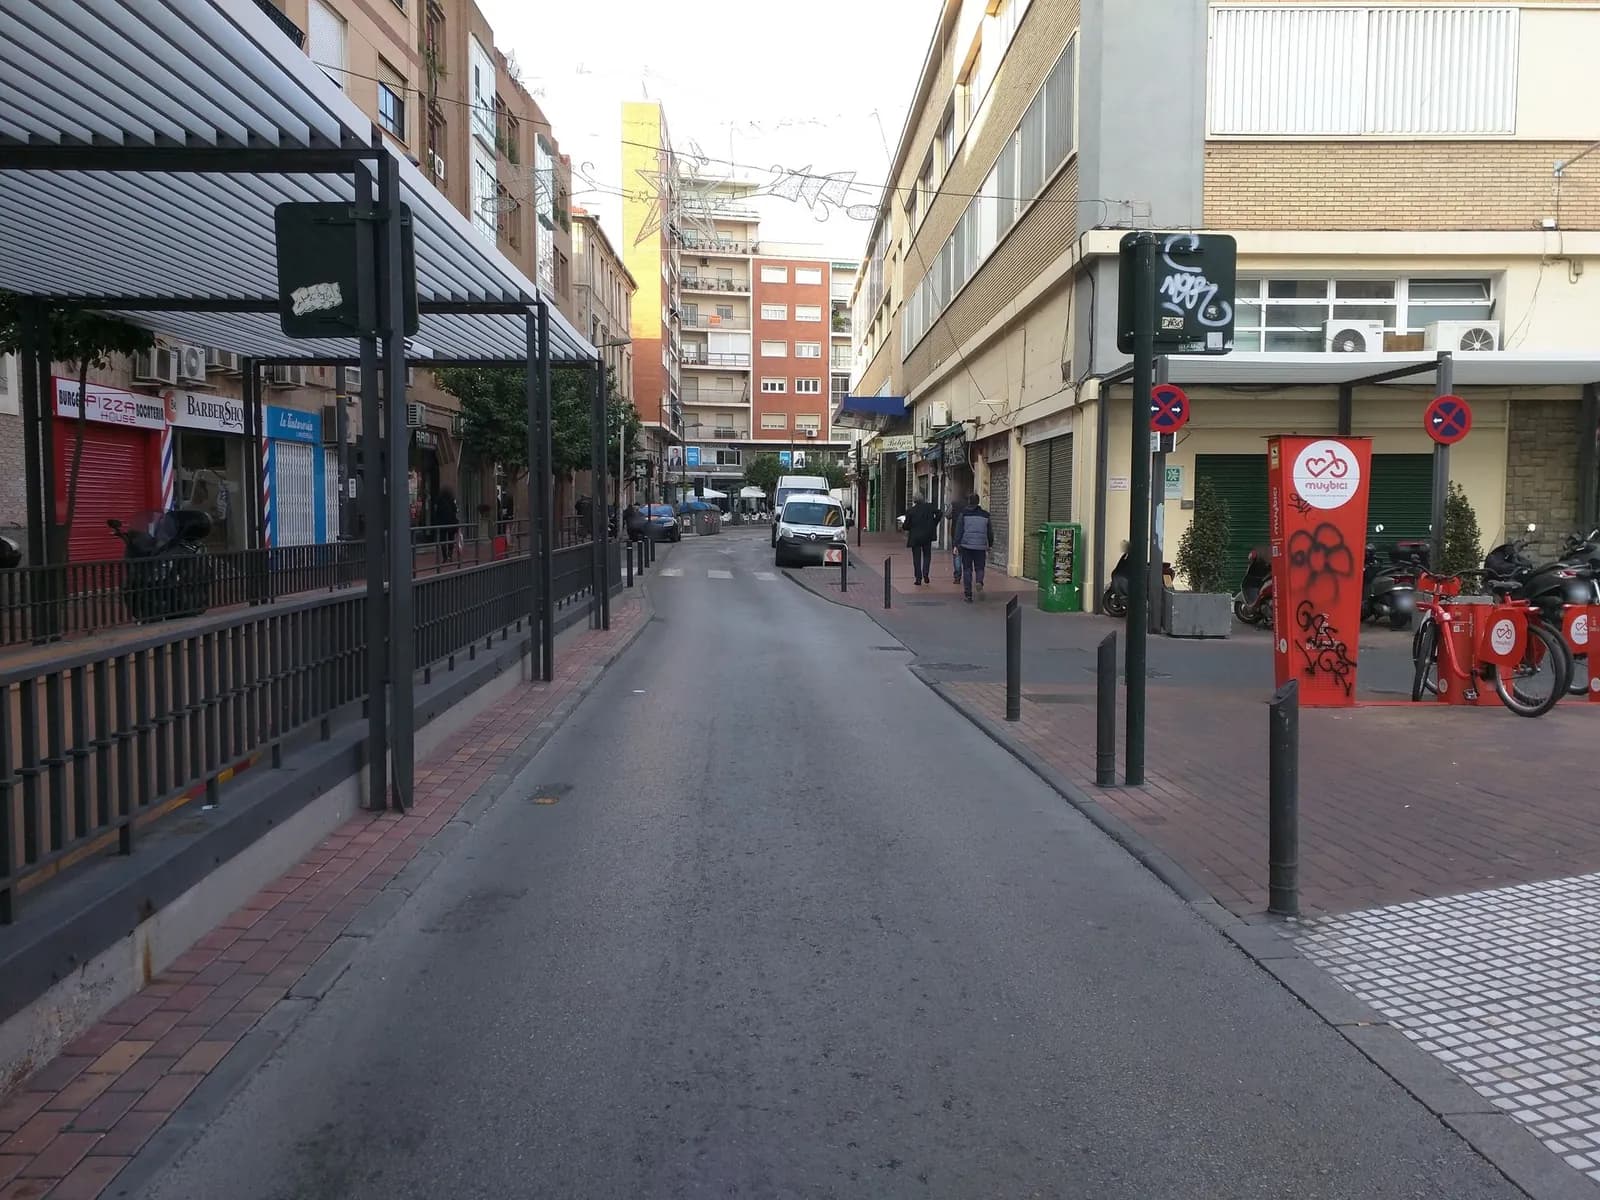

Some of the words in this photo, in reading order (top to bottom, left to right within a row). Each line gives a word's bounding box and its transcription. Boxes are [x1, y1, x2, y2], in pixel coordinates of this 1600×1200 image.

[59, 389, 80, 407] BURGE
[86, 395, 135, 413] PIZZA
[101, 412, 136, 424] HOUSE
[187, 395, 244, 423] BARBERSHO
[1305, 481, 1348, 492] muybici
